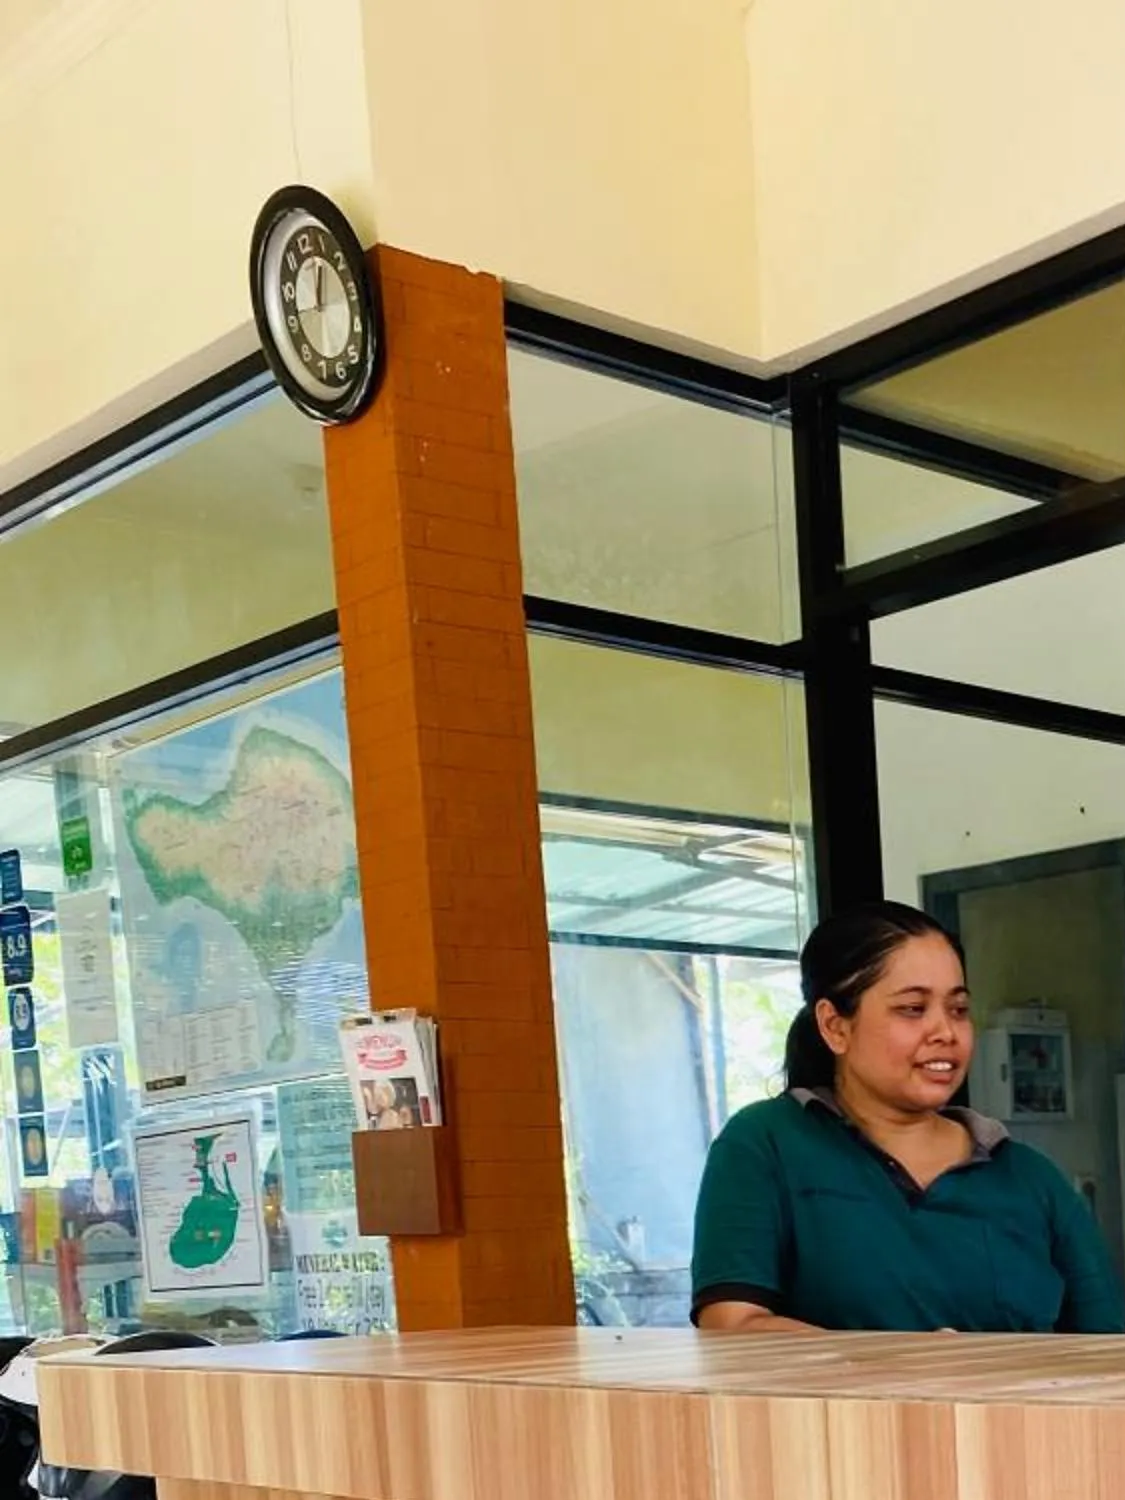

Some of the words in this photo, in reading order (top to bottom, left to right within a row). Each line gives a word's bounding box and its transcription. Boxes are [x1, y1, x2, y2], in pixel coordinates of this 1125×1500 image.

[297, 233, 313, 253] 12
[318, 234, 326, 252] 1
[333, 252, 347, 271] 2
[281, 281, 295, 301] 10
[347, 281, 359, 300] 3
[287, 316, 299, 333] 9
[353, 316, 363, 333] 4
[301, 343, 313, 362] 8
[347, 345, 359, 364] 5
[317, 360, 328, 380] 7
[334, 361, 347, 379] 6
[7, 934, 27, 959] 8.9
